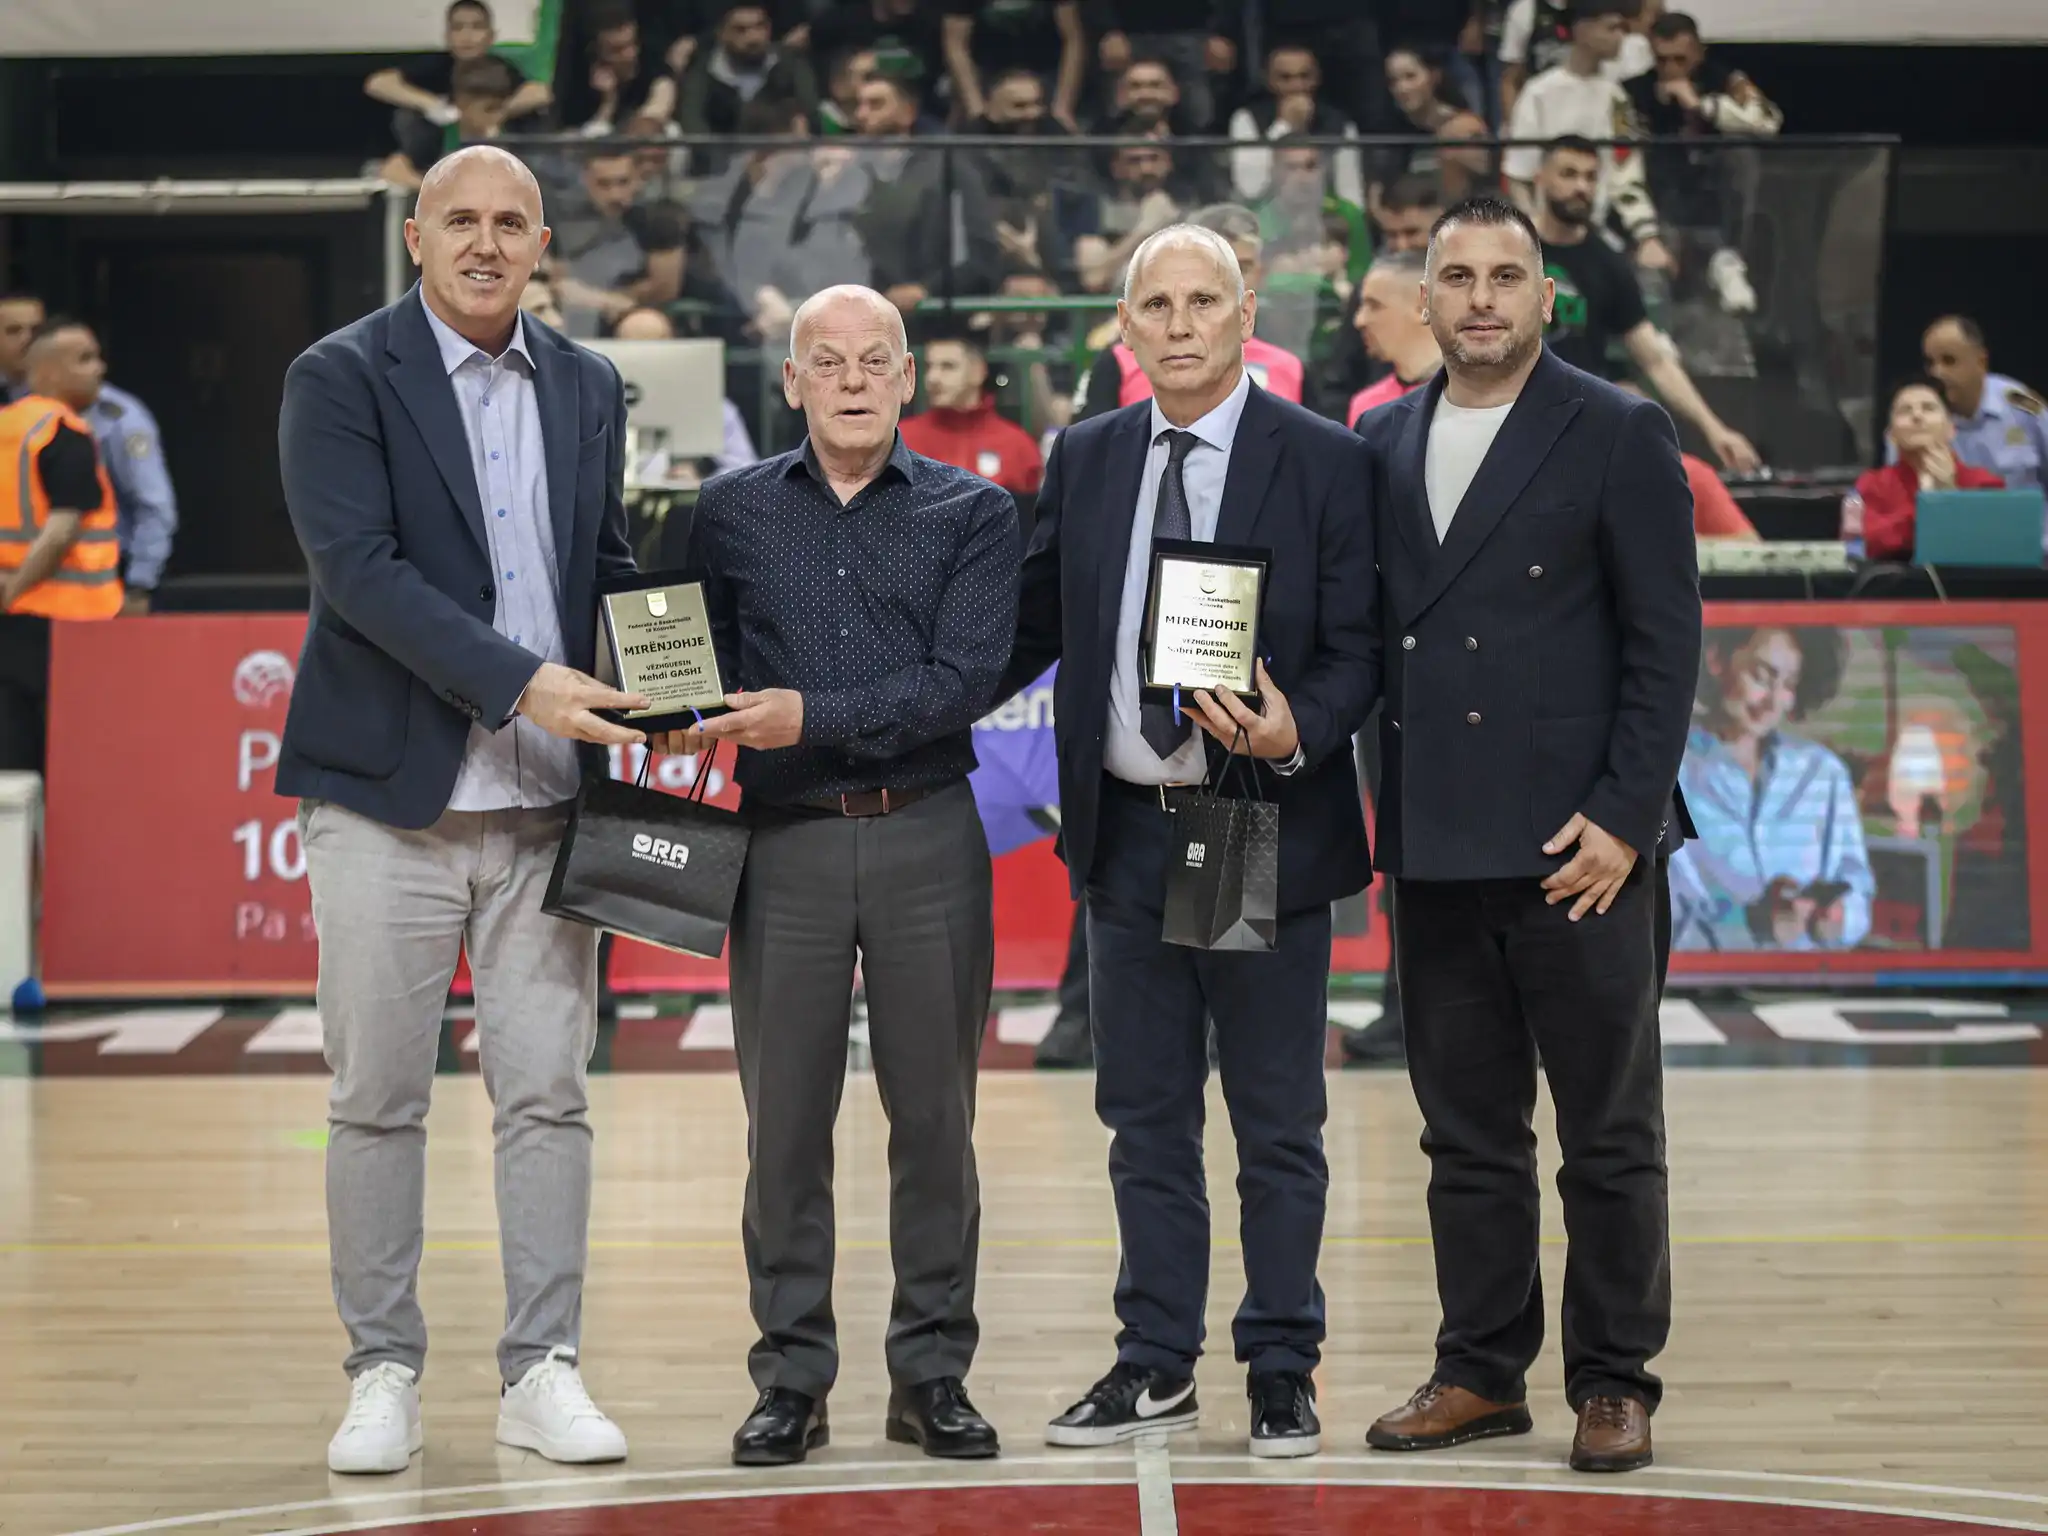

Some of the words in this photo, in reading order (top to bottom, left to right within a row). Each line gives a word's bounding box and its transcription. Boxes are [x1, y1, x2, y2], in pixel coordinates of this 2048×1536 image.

[1165, 615, 1248, 632] MIRËNJOHJE
[624, 636, 706, 656] MIRËNJOHJE
[1195, 648, 1242, 660] PARDUZI
[638, 670, 668, 682] Mehdi
[670, 666, 702, 678] GASHI
[646, 660, 692, 671] VËZHGUESIN
[971, 688, 1054, 732] en
[632, 833, 689, 865] ORA
